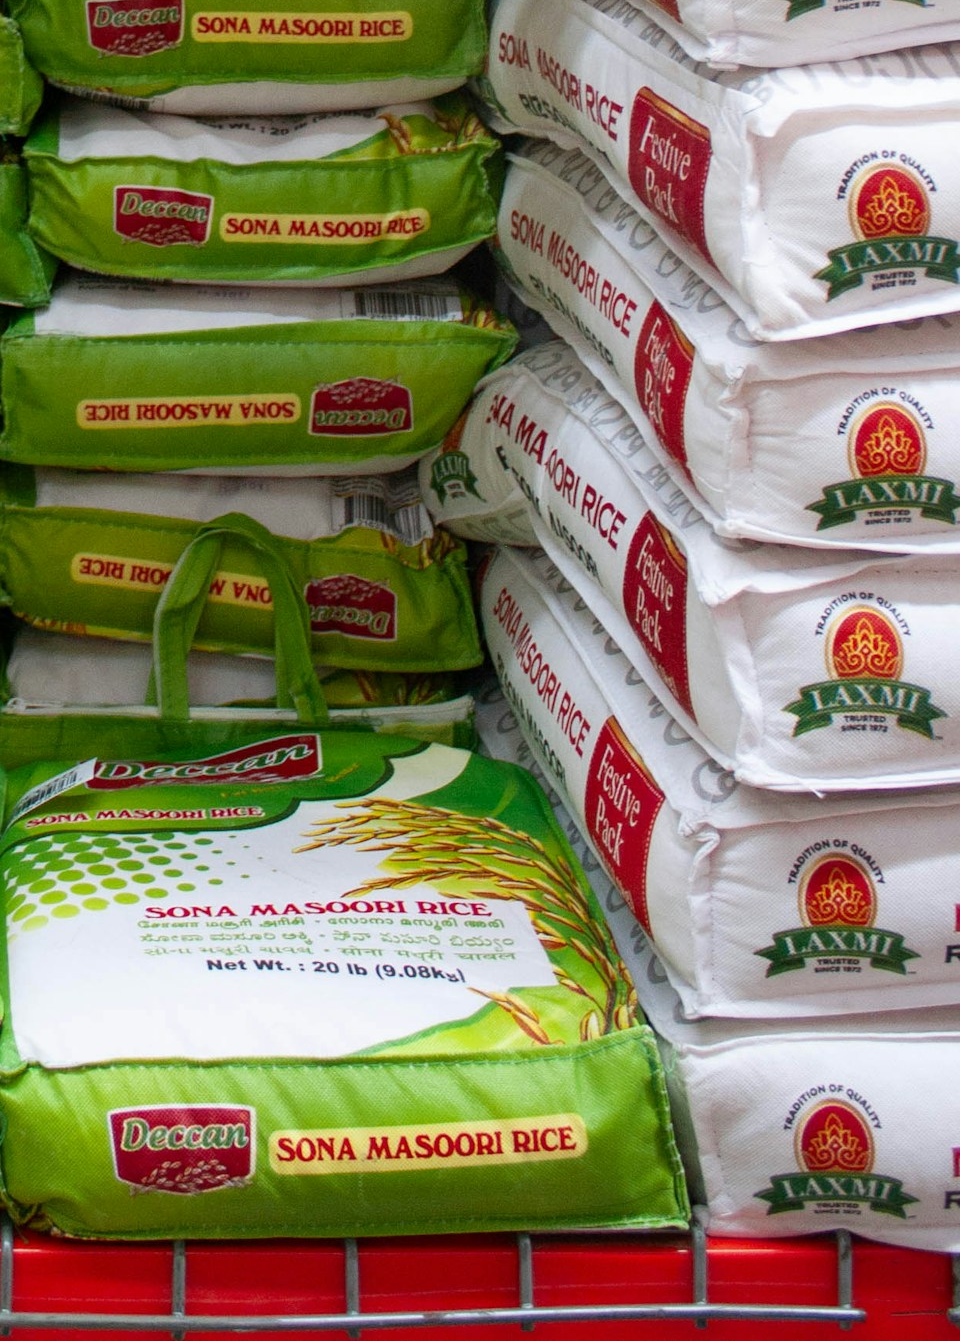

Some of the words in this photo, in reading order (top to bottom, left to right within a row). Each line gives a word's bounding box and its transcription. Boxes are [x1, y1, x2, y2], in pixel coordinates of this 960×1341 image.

[94, 6, 179, 27] Deccan
[197, 17, 250, 35] SONA
[258, 17, 353, 36] MASOORI
[359, 18, 405, 37] RICE
[639, 115, 692, 181] Festive
[836, 150, 879, 202] TRADITION
[881, 150, 897, 158] OF
[899, 152, 938, 194] QUALITY
[122, 192, 207, 223] Deccan
[644, 166, 679, 224] Pack
[226, 217, 280, 236] SONA
[287, 219, 382, 238] MASOORI
[386, 215, 424, 234] RICE
[841, 242, 948, 272] LAXMI
[873, 271, 915, 280] TRUSTED
[84, 403, 130, 421] RICE
[135, 402, 229, 420] MASOORI
[241, 401, 295, 419] SONA
[317, 408, 404, 428] Deccan
[835, 482, 944, 508] LAXMI
[815, 592, 857, 637] TRADITION
[859, 592, 874, 600] OF
[876, 596, 911, 637] QUALITY
[493, 587, 523, 645] SONA
[515, 622, 561, 718] MASOORI
[556, 691, 591, 759] RICE
[811, 685, 920, 712] LAXMI
[844, 715, 886, 724] TRUSTED
[96, 743, 313, 780] Deccan
[597, 744, 641, 828] Festive
[26, 813, 87, 827] SONA
[96, 808, 204, 820] MASOORI
[210, 806, 264, 818] RICE
[596, 795, 625, 867] Pack
[145, 905, 238, 918] SONA
[250, 901, 408, 916] MASOORI
[415, 901, 492, 917] RICE
[785, 930, 896, 955] LAXMI
[207, 960, 246, 971] Net
[254, 960, 291, 972] Wt.
[313, 961, 339, 974] 20
[348, 963, 368, 976] lb
[120, 1117, 249, 1151] Deccan
[276, 1137, 356, 1162] SONA
[366, 1132, 501, 1159] MASOORI
[512, 1125, 577, 1153] RICE
[782, 1178, 892, 1200] LAXMI
